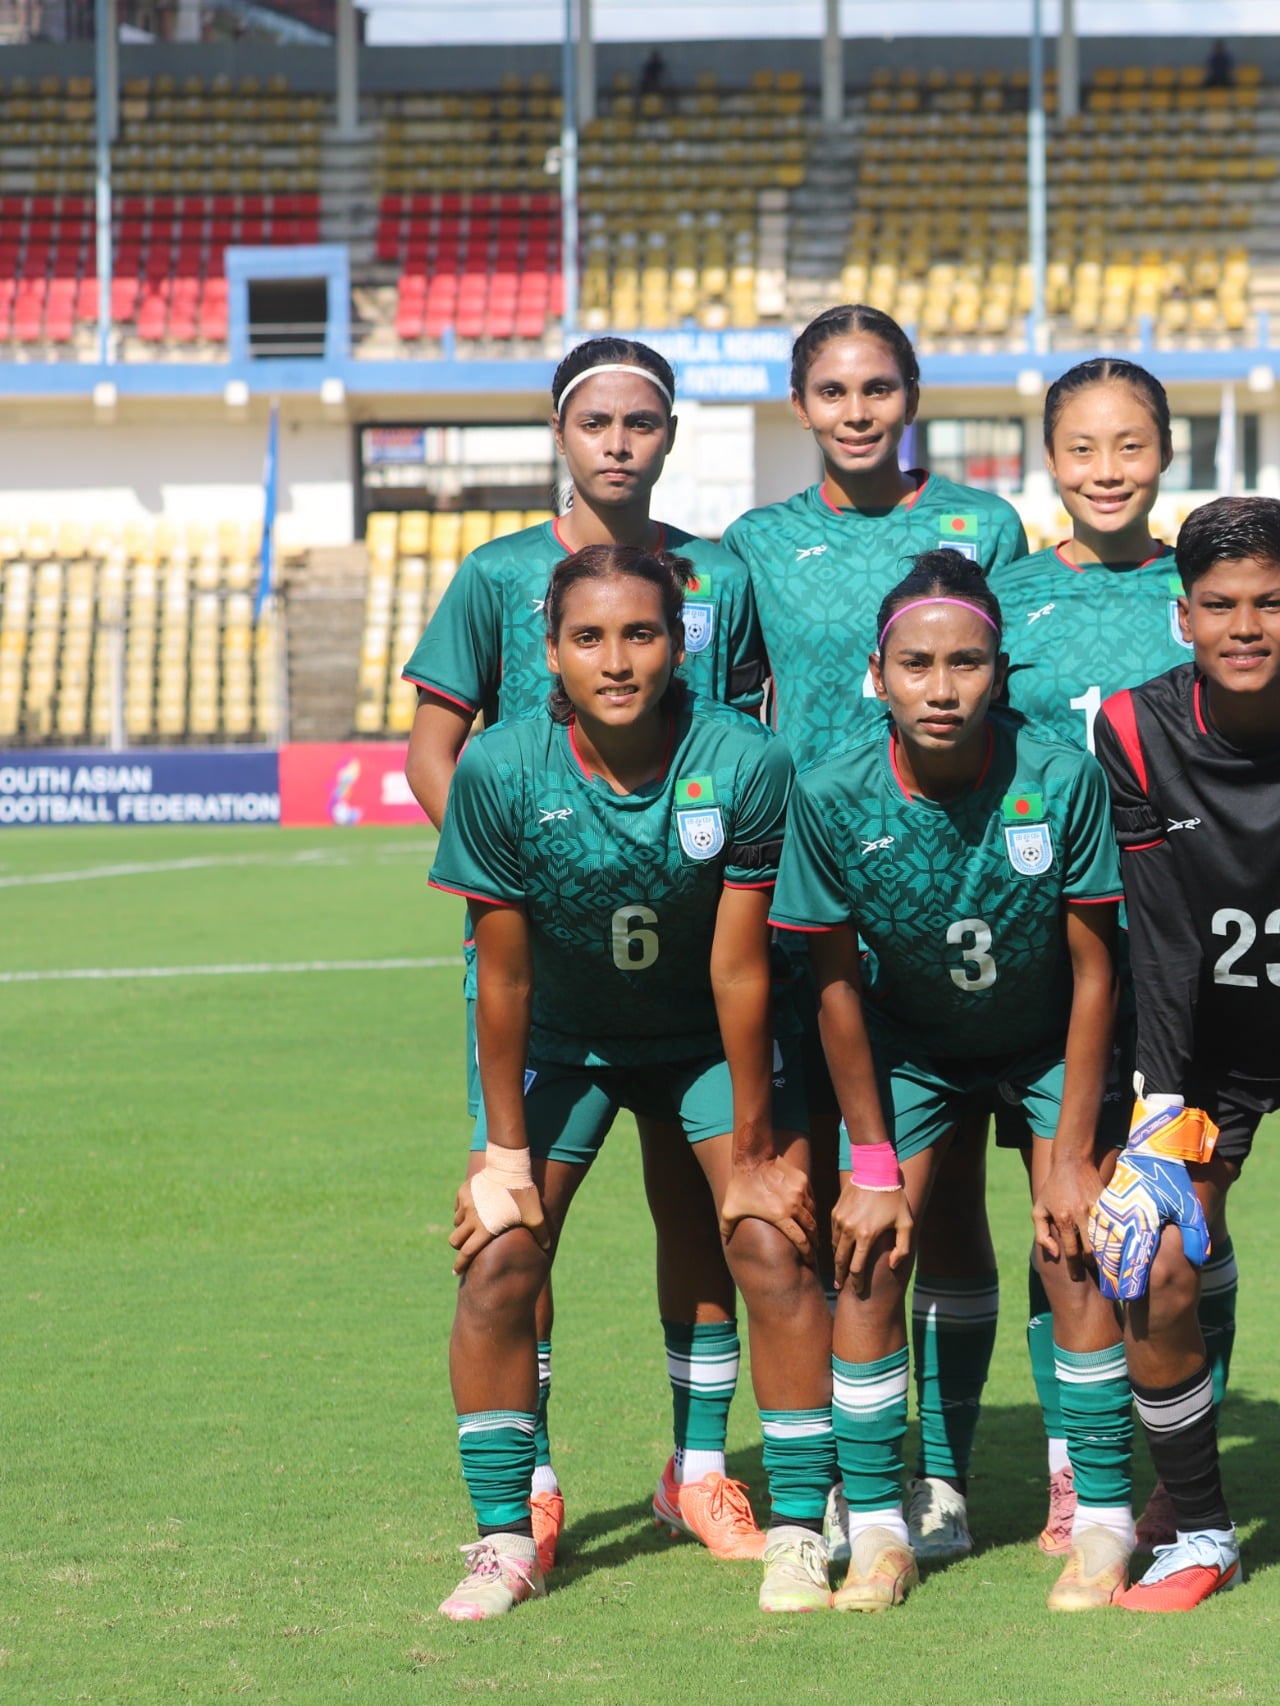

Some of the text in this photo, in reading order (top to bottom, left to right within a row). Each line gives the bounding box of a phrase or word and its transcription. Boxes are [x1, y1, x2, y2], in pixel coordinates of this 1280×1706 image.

[72, 765, 153, 794] ASIAN
[117, 792, 281, 822] FEDERATION
[611, 904, 659, 971] 6
[946, 918, 997, 992] 3
